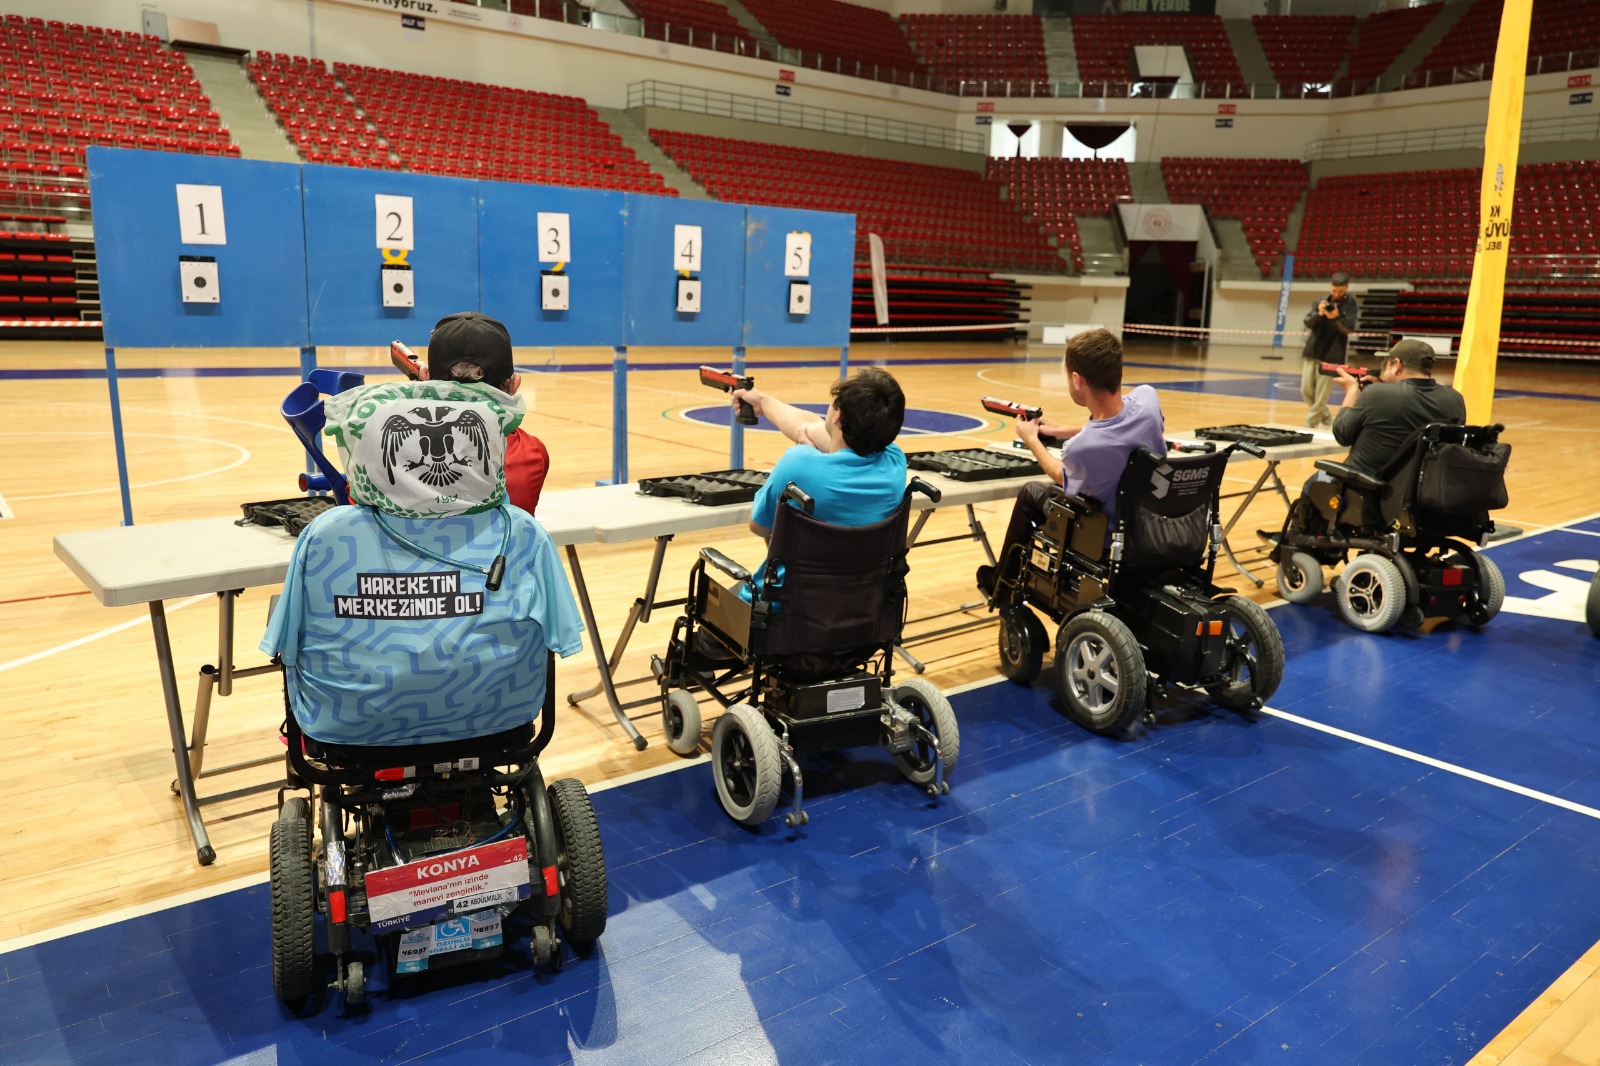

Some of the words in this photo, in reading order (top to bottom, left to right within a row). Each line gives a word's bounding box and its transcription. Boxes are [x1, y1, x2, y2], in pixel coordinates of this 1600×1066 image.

[194, 202, 210, 236] 1
[385, 211, 404, 242] 2
[546, 227, 561, 256] 3
[680, 238, 695, 264] 4
[791, 246, 804, 270] 5
[1172, 466, 1210, 482] SGMS
[360, 574, 457, 595] HAREKETİN
[337, 596, 447, 617] MERKEZİNDE
[454, 594, 481, 614] OL!
[416, 854, 480, 880] KONYA
[512, 853, 523, 862] 42
[464, 874, 489, 884] izinde
[413, 893, 444, 907] manevi
[456, 900, 469, 909] 42
[377, 915, 411, 929] TÜRKİYE
[402, 947, 427, 956] 46937
